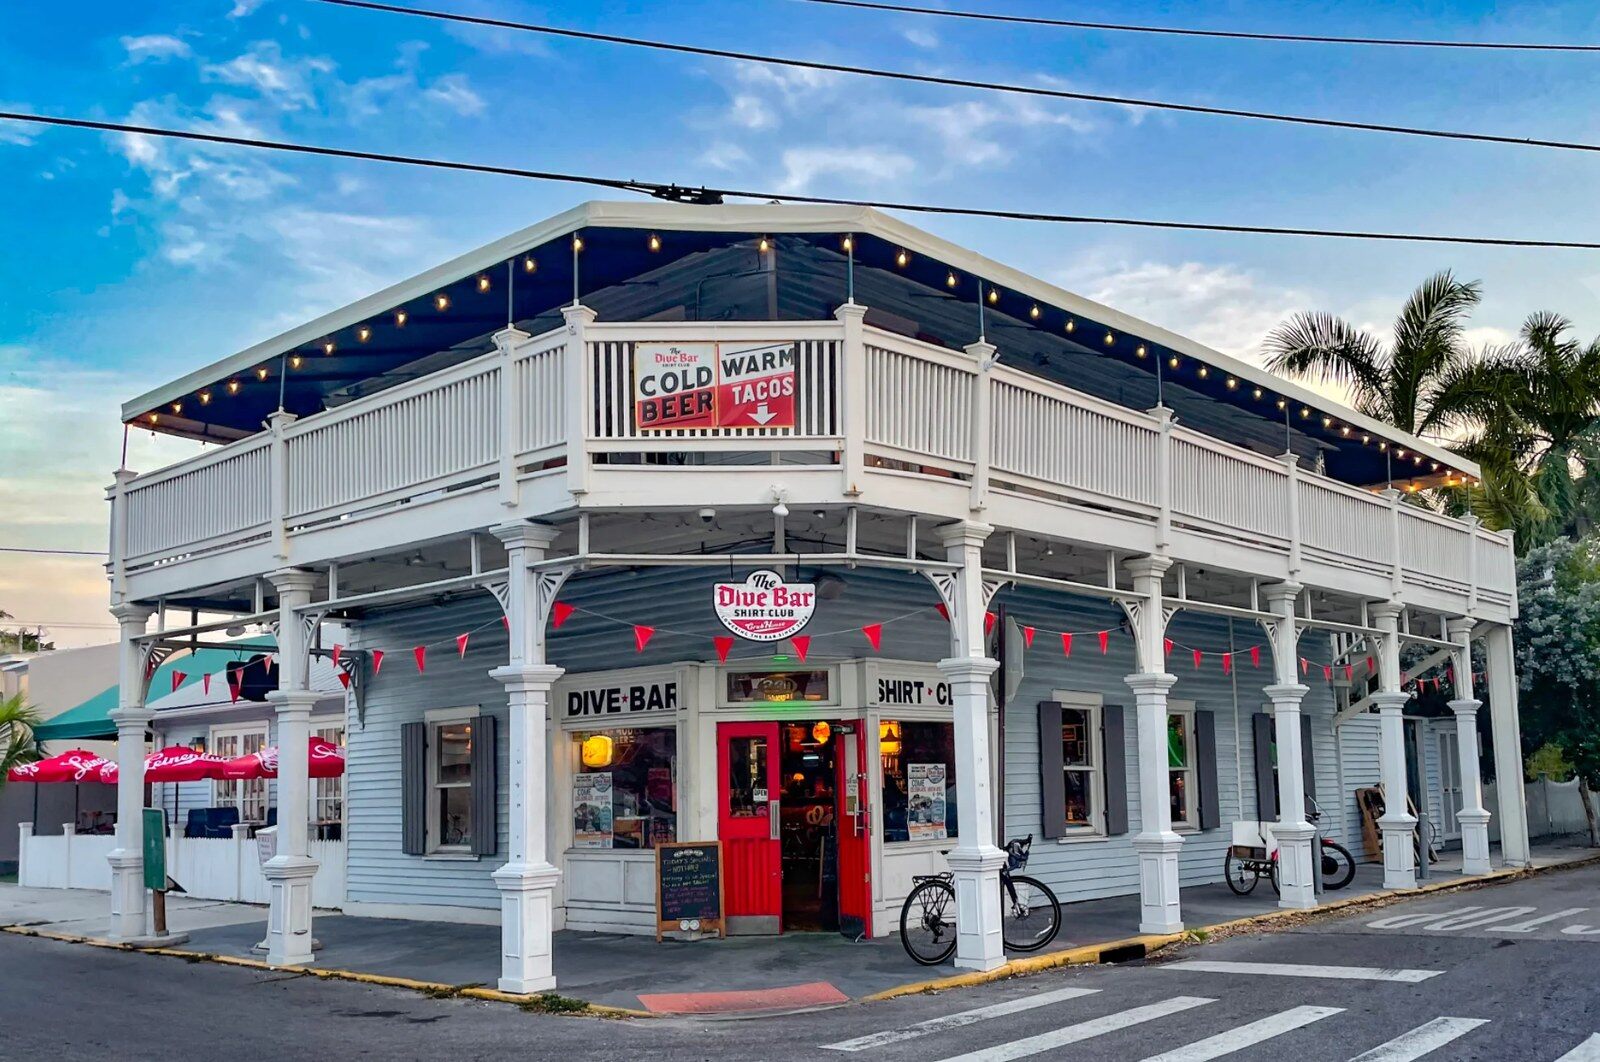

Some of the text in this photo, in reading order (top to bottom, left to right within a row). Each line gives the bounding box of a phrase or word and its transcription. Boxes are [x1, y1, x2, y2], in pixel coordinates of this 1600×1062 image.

[655, 352, 699, 363] Dive Bar
[721, 347, 795, 378] WARM
[640, 366, 713, 397] COLD
[732, 376, 794, 405] TACOS
[642, 391, 713, 423] BEER
[753, 574, 777, 590] The
[718, 585, 814, 608] Dive Bar
[721, 615, 748, 637] LOWERING
[734, 608, 794, 618] SHIRT CLUB
[568, 682, 677, 717] DIVE BAR
[878, 678, 954, 706] SHIRT CL
